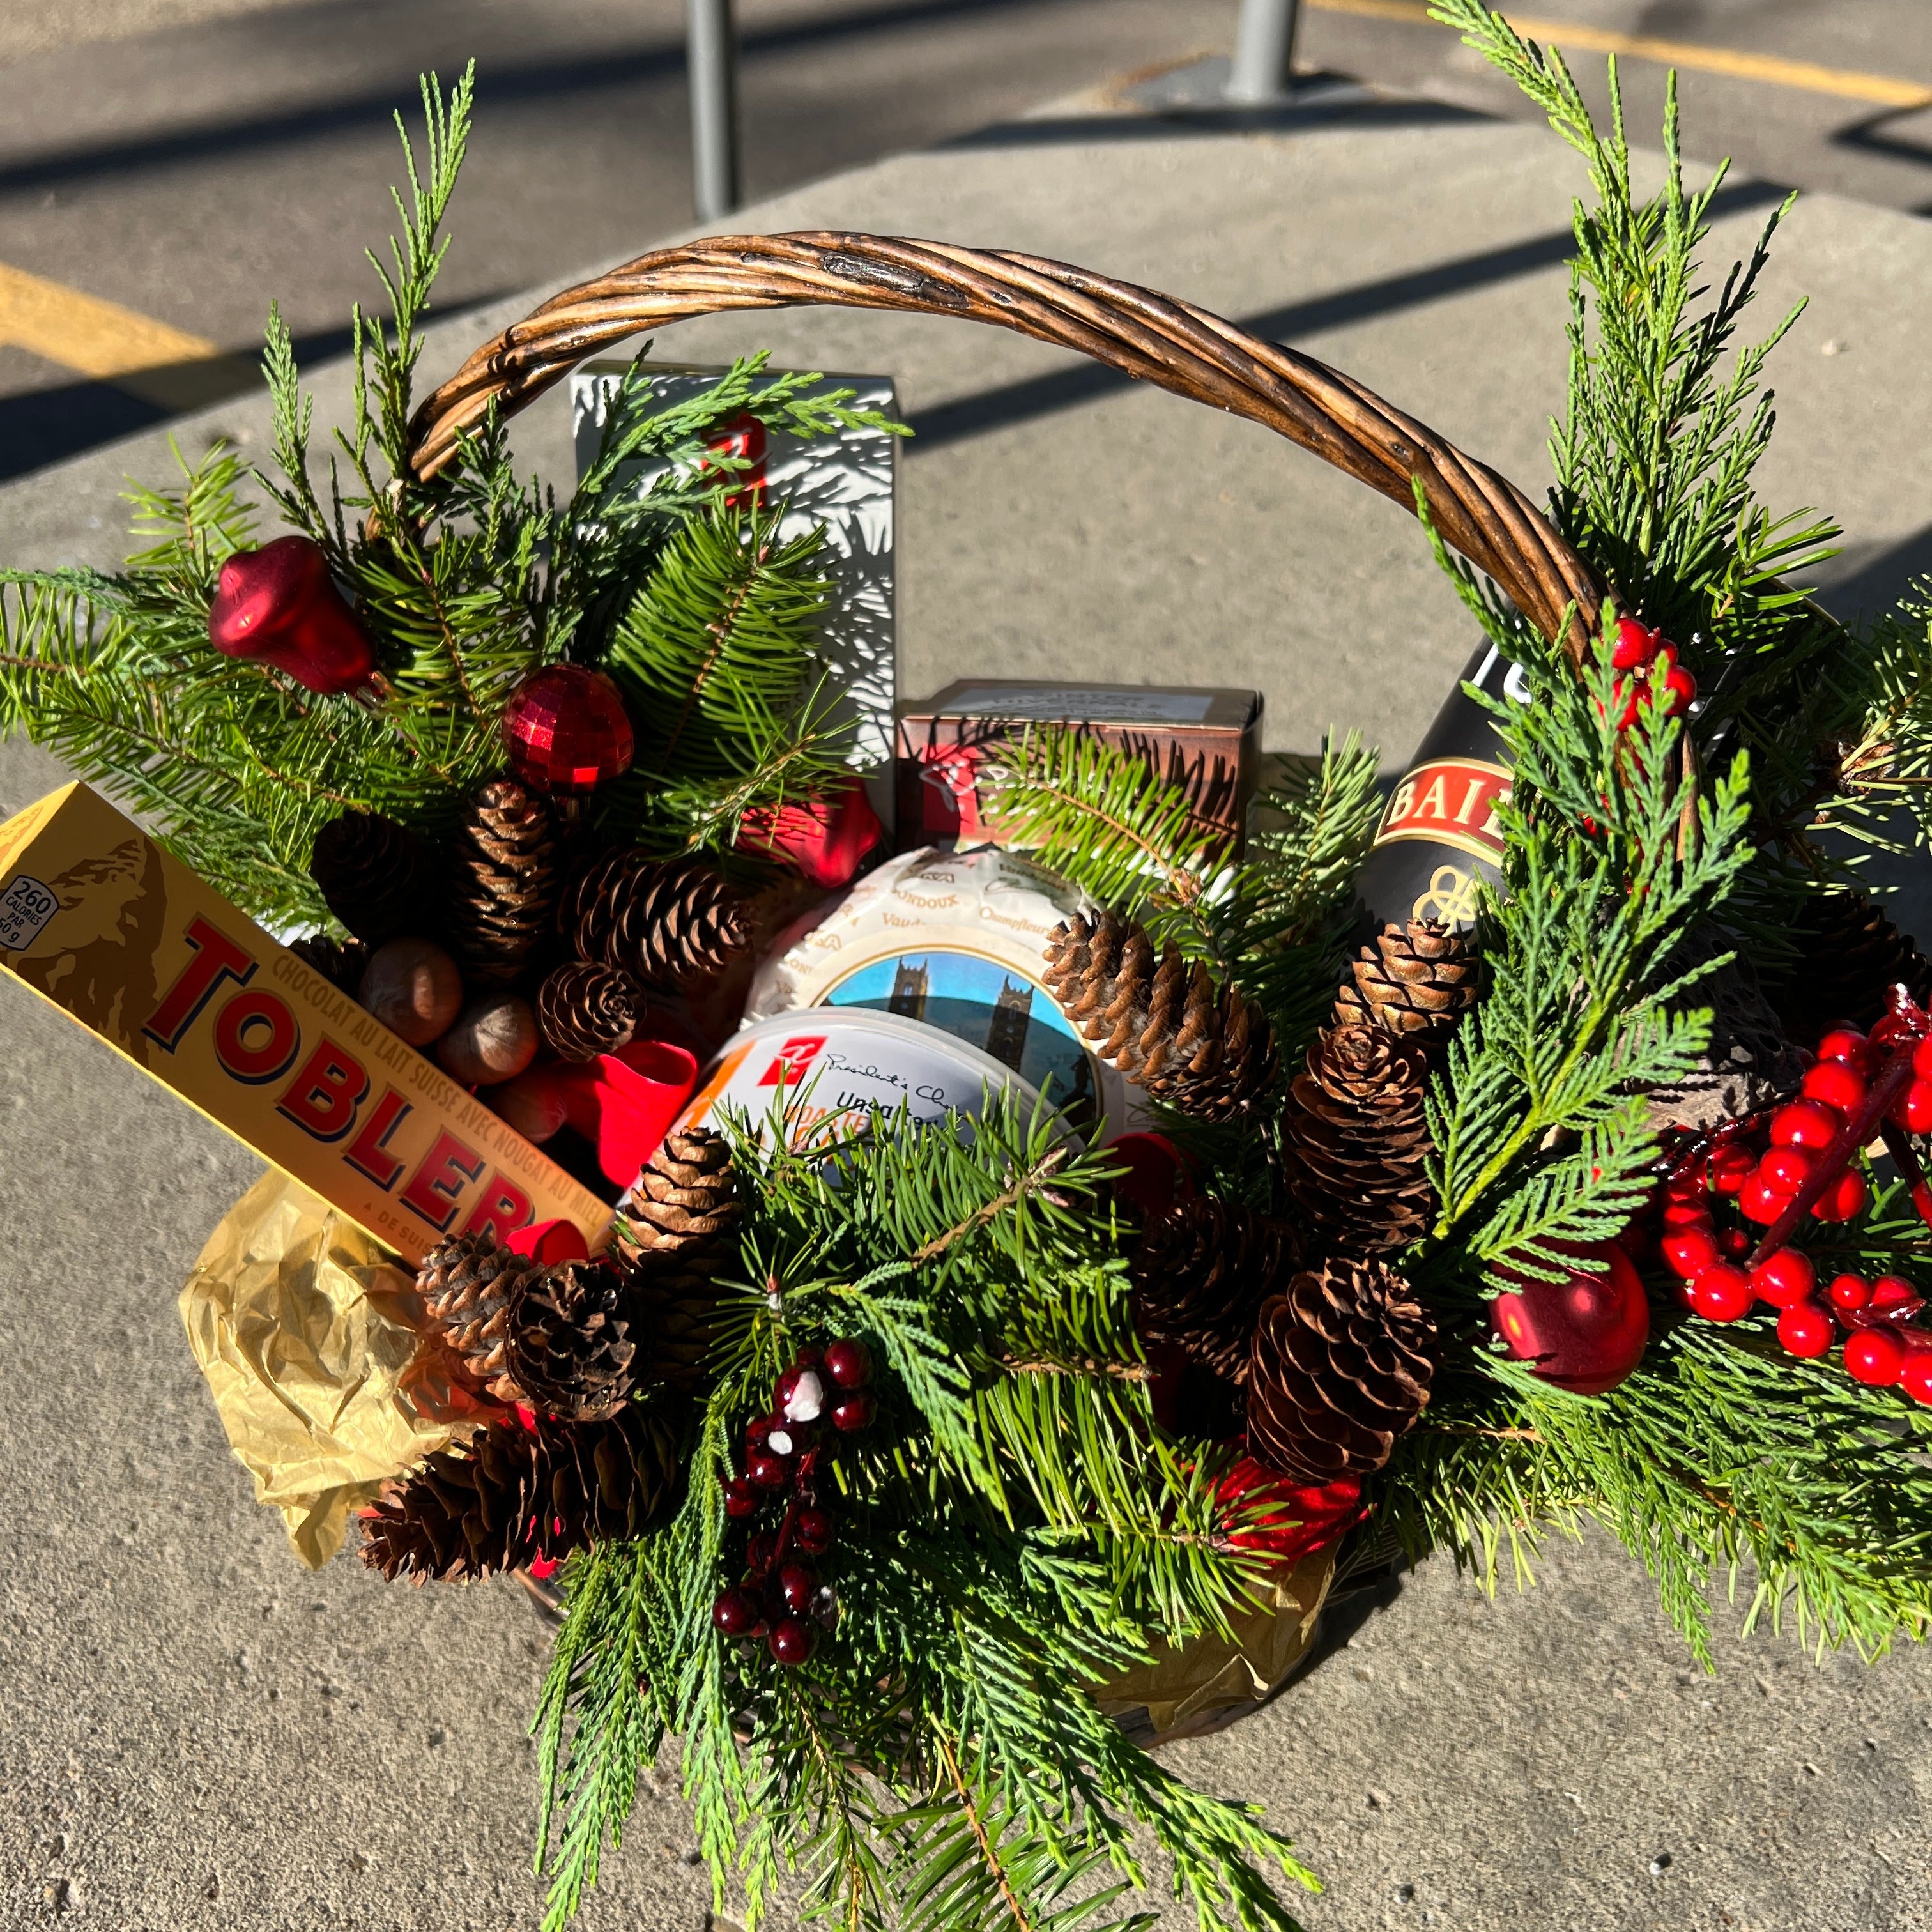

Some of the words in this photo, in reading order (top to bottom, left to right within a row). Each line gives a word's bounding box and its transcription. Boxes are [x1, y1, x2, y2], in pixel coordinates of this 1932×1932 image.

[13, 880, 52, 914] 260
[891, 889, 959, 909] ONDOUX
[6, 896, 42, 926] CALORIES
[7, 912, 25, 928] PAR
[8, 931, 20, 943] g
[272, 954, 356, 1028] CHOCOLAT
[349, 1017, 380, 1046] AU
[374, 1035, 415, 1074] LAIT
[409, 1062, 462, 1114] SUISSE
[457, 1101, 498, 1142] AVEC
[493, 1128, 550, 1184] NOUGAT
[548, 1174, 576, 1201] AU
[569, 1192, 603, 1227] MIEL
[378, 1211, 399, 1230] DE
